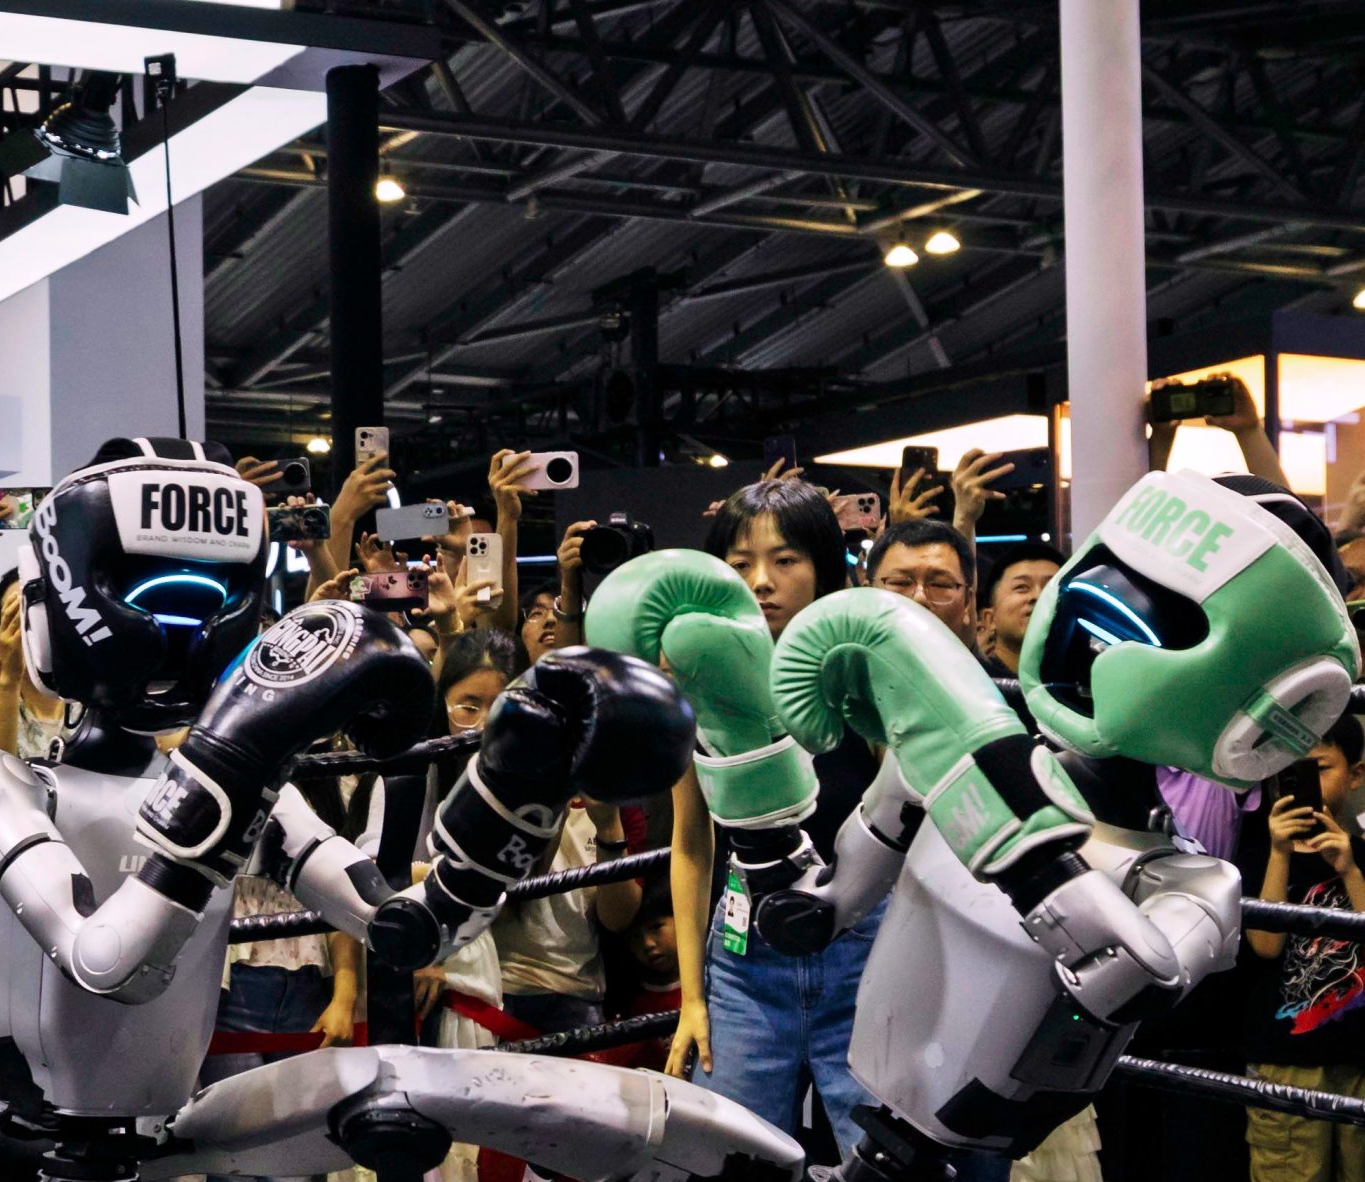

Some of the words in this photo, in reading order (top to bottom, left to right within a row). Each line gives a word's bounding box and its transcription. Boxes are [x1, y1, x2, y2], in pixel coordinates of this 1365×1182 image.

[141, 483, 249, 538] FORCE
[1115, 484, 1235, 574] FORCE
[35, 502, 114, 648] BOOM!
